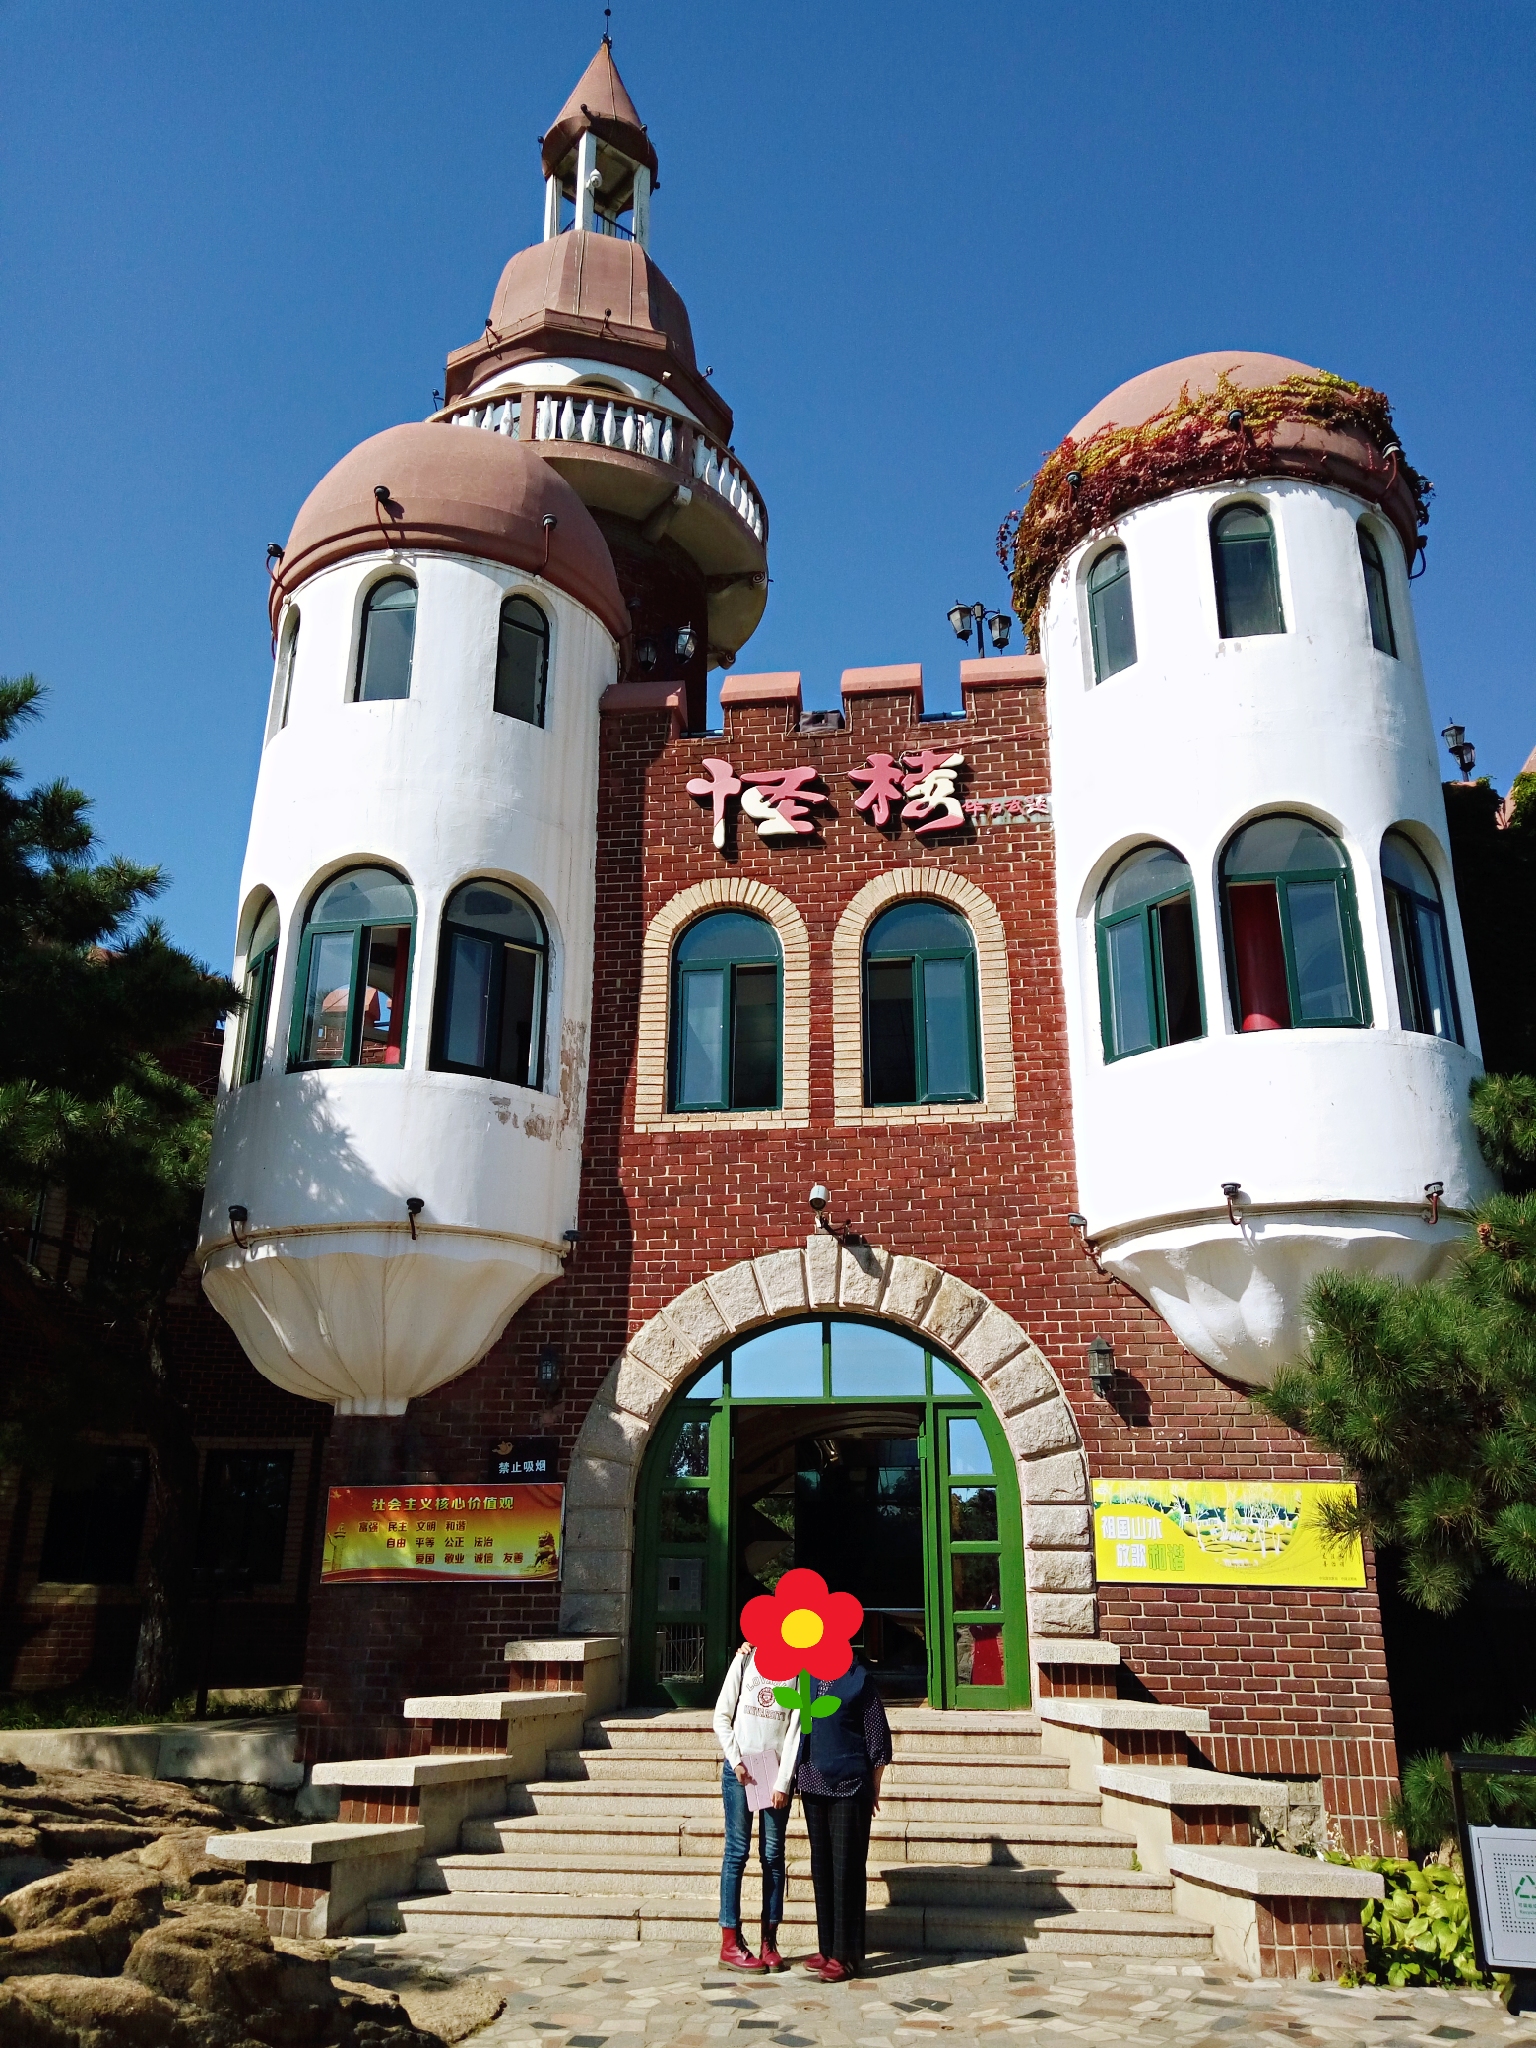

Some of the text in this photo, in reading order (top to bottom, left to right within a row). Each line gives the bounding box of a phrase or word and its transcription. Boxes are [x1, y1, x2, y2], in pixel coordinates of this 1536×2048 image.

[498, 1459, 546, 1474] 禁止吸烟
[371, 1496, 514, 1512] 社会主义核心价值观
[358, 1520, 466, 1533] 富强 民主 文明 和谐
[1100, 1515, 1163, 1540] 祖国山水
[386, 1537, 493, 1549] 自由 平等 公正 法治
[415, 1552, 524, 1565] 爱国 敬业 诚信 友善
[1116, 1543, 1185, 1571] 放歌和谐
